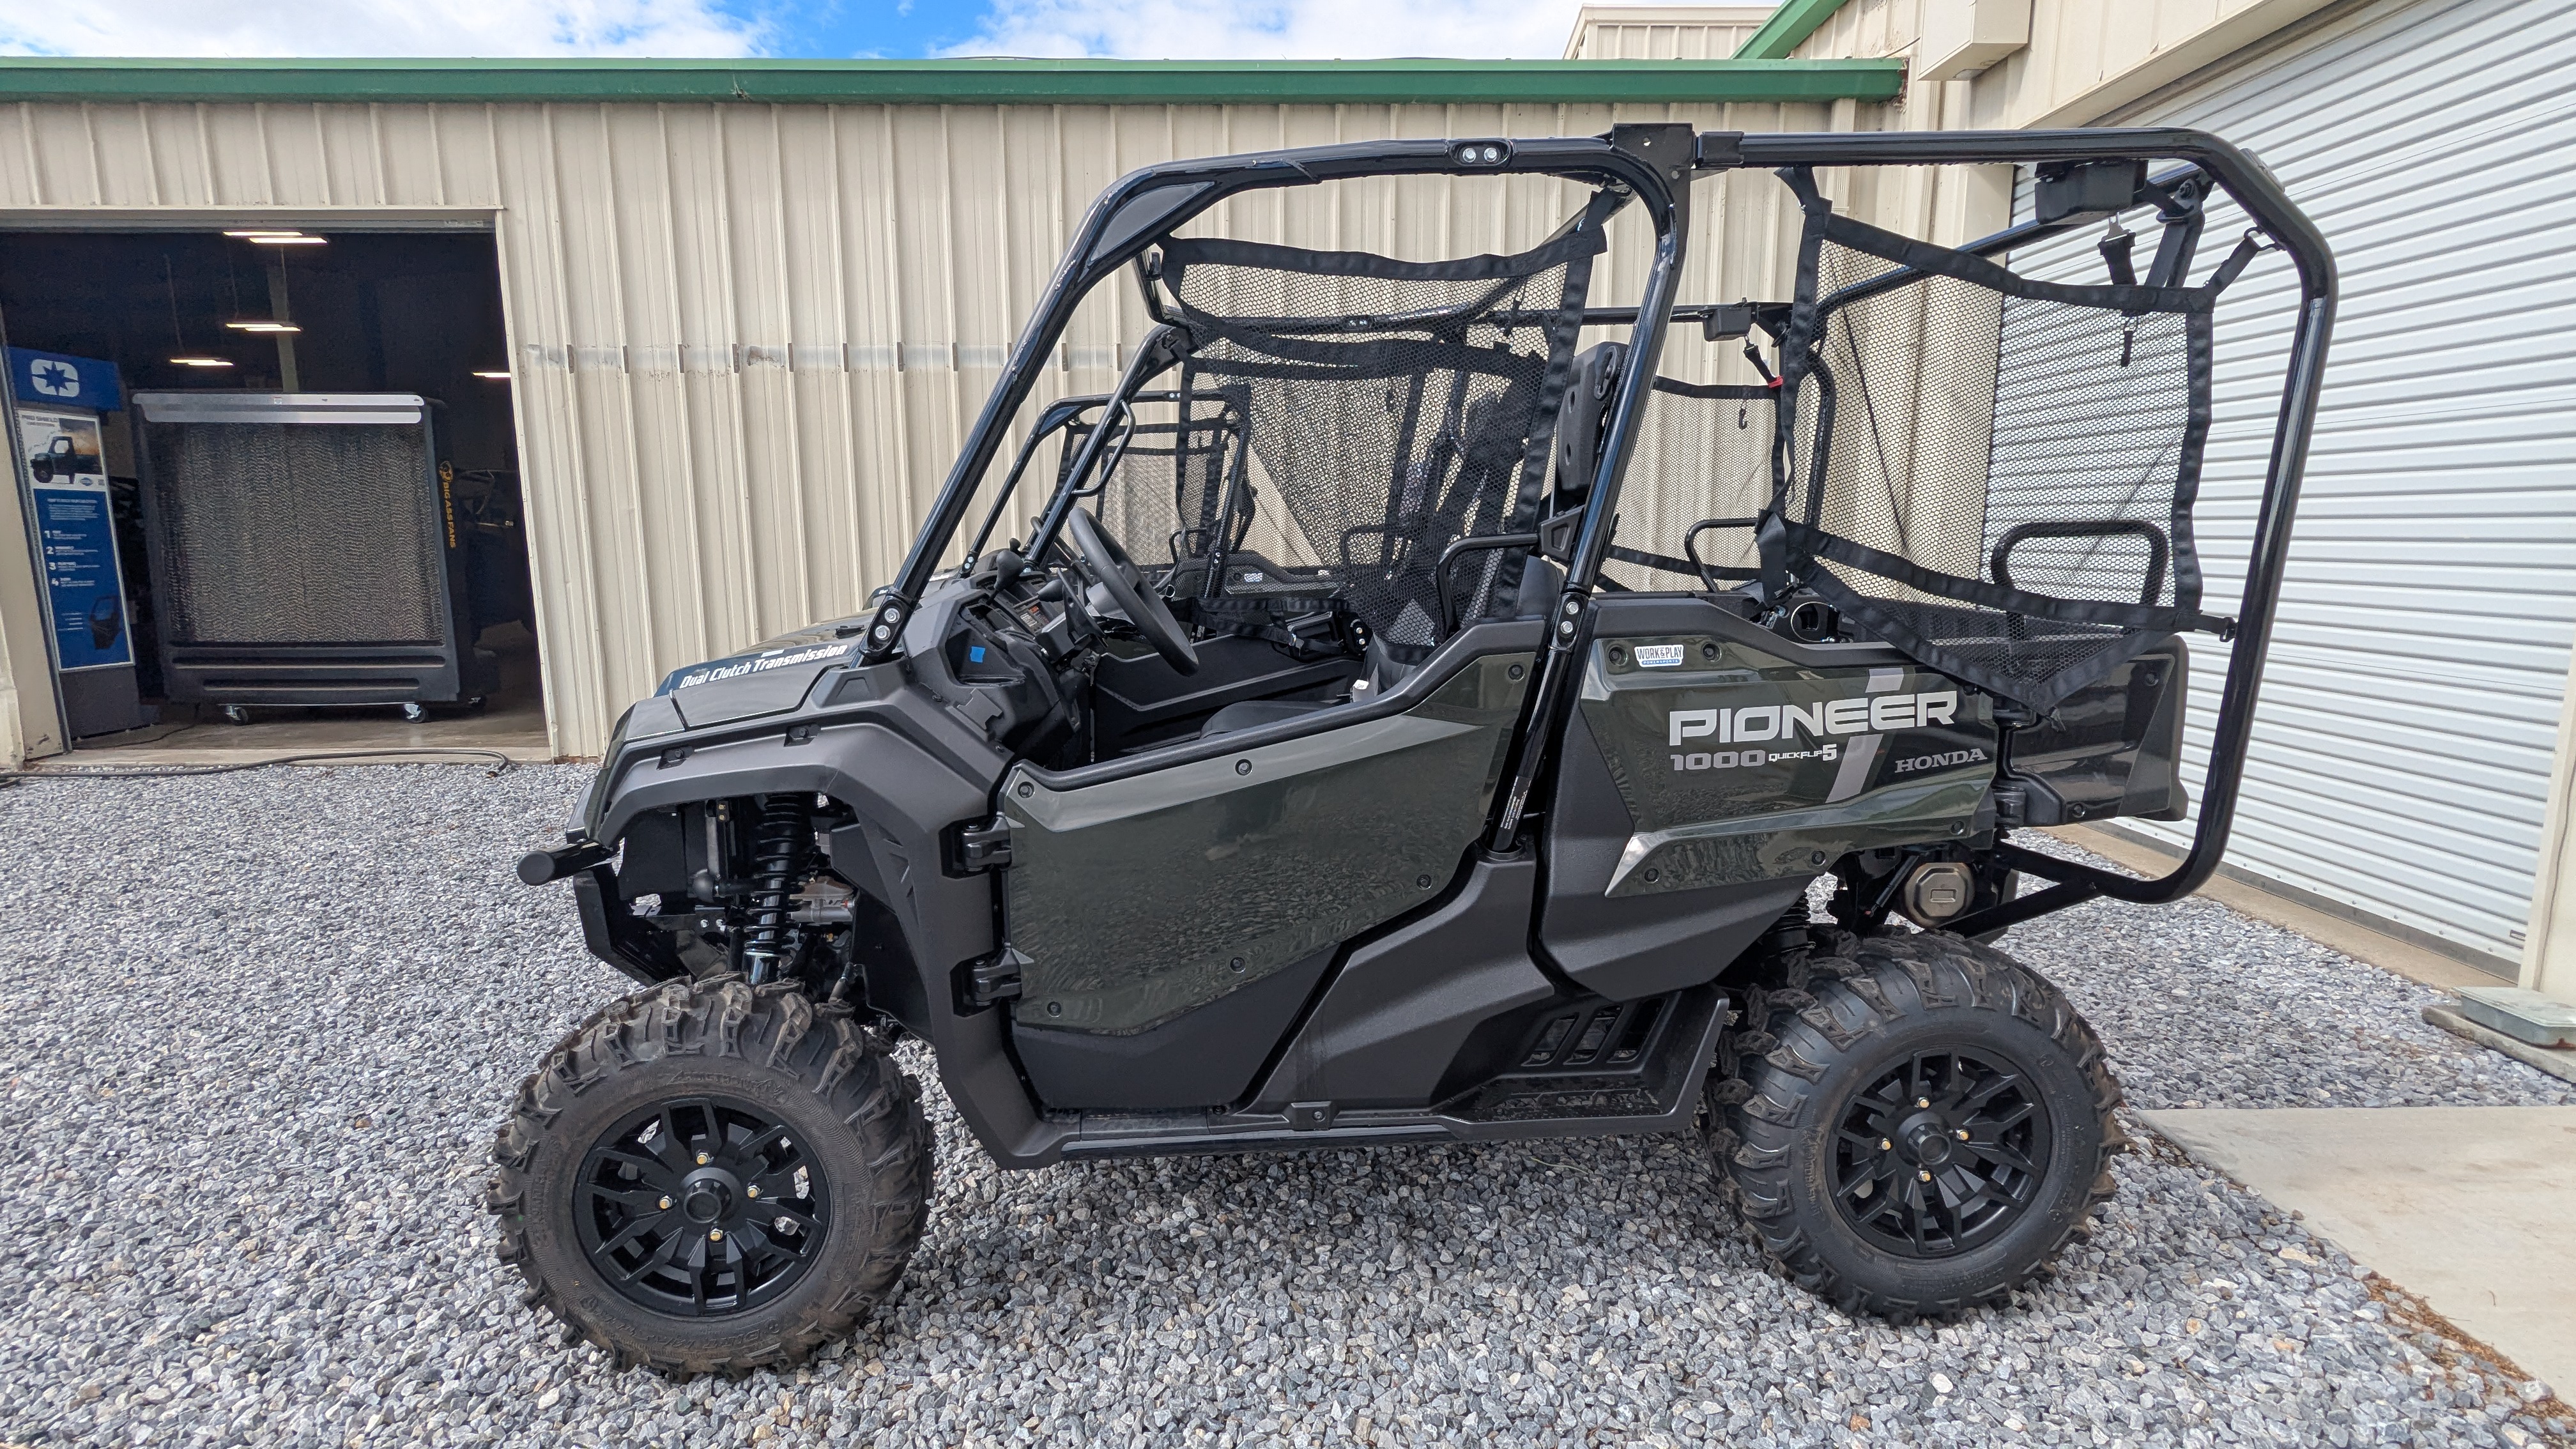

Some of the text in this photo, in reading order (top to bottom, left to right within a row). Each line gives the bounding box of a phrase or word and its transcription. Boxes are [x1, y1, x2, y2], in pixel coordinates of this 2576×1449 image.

[49, 562, 56, 571] 3
[1637, 647, 1660, 659] WORK
[1665, 646, 1682, 658] PLAY
[679, 644, 848, 689] Dual Clutch Transmission
[1669, 691, 1957, 746] PIONEER
[1670, 749, 1766, 771] 1000
[1894, 748, 1988, 773] HONDA
